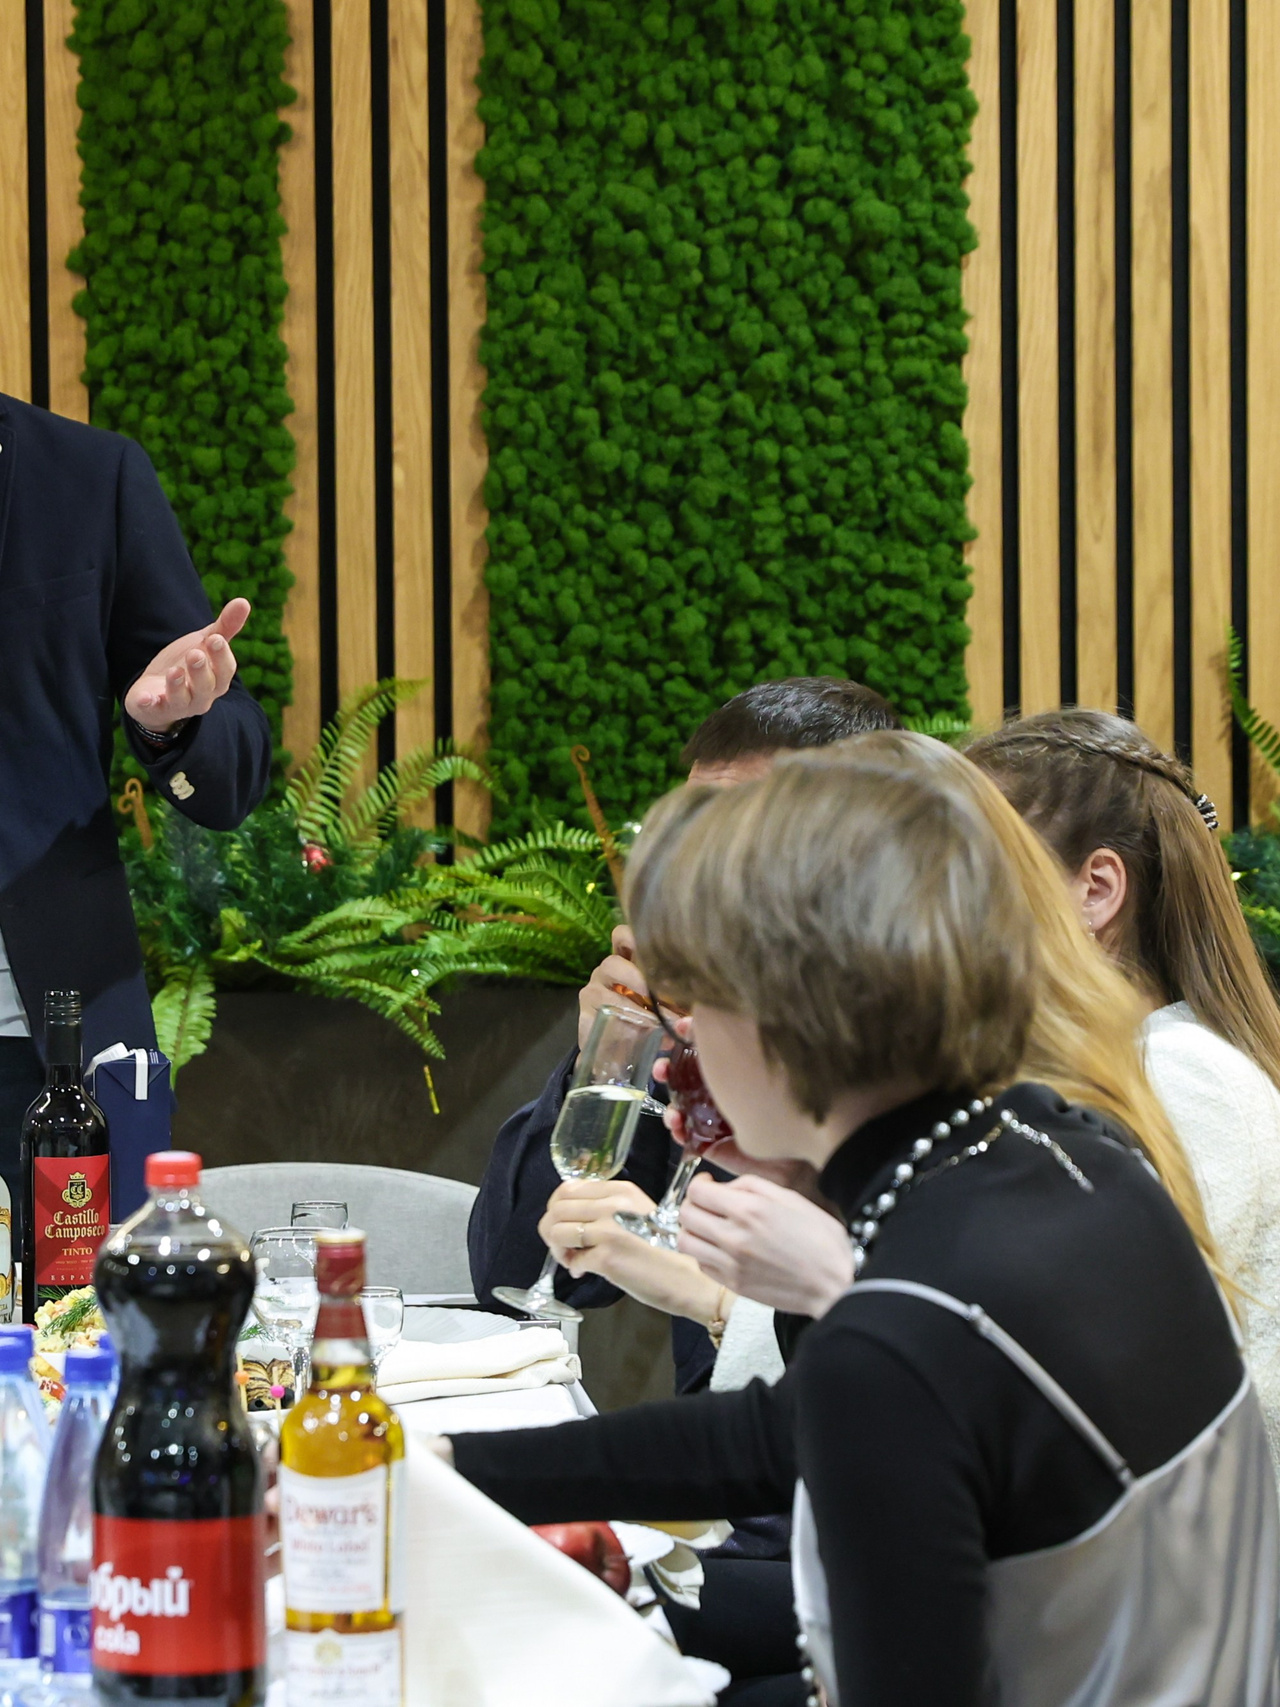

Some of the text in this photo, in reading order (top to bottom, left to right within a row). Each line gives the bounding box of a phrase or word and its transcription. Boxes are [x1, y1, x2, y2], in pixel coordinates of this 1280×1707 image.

[53, 1208, 99, 1226] Castillo
[44, 1224, 106, 1243] Camposeco
[62, 1247, 93, 1256] TINTO
